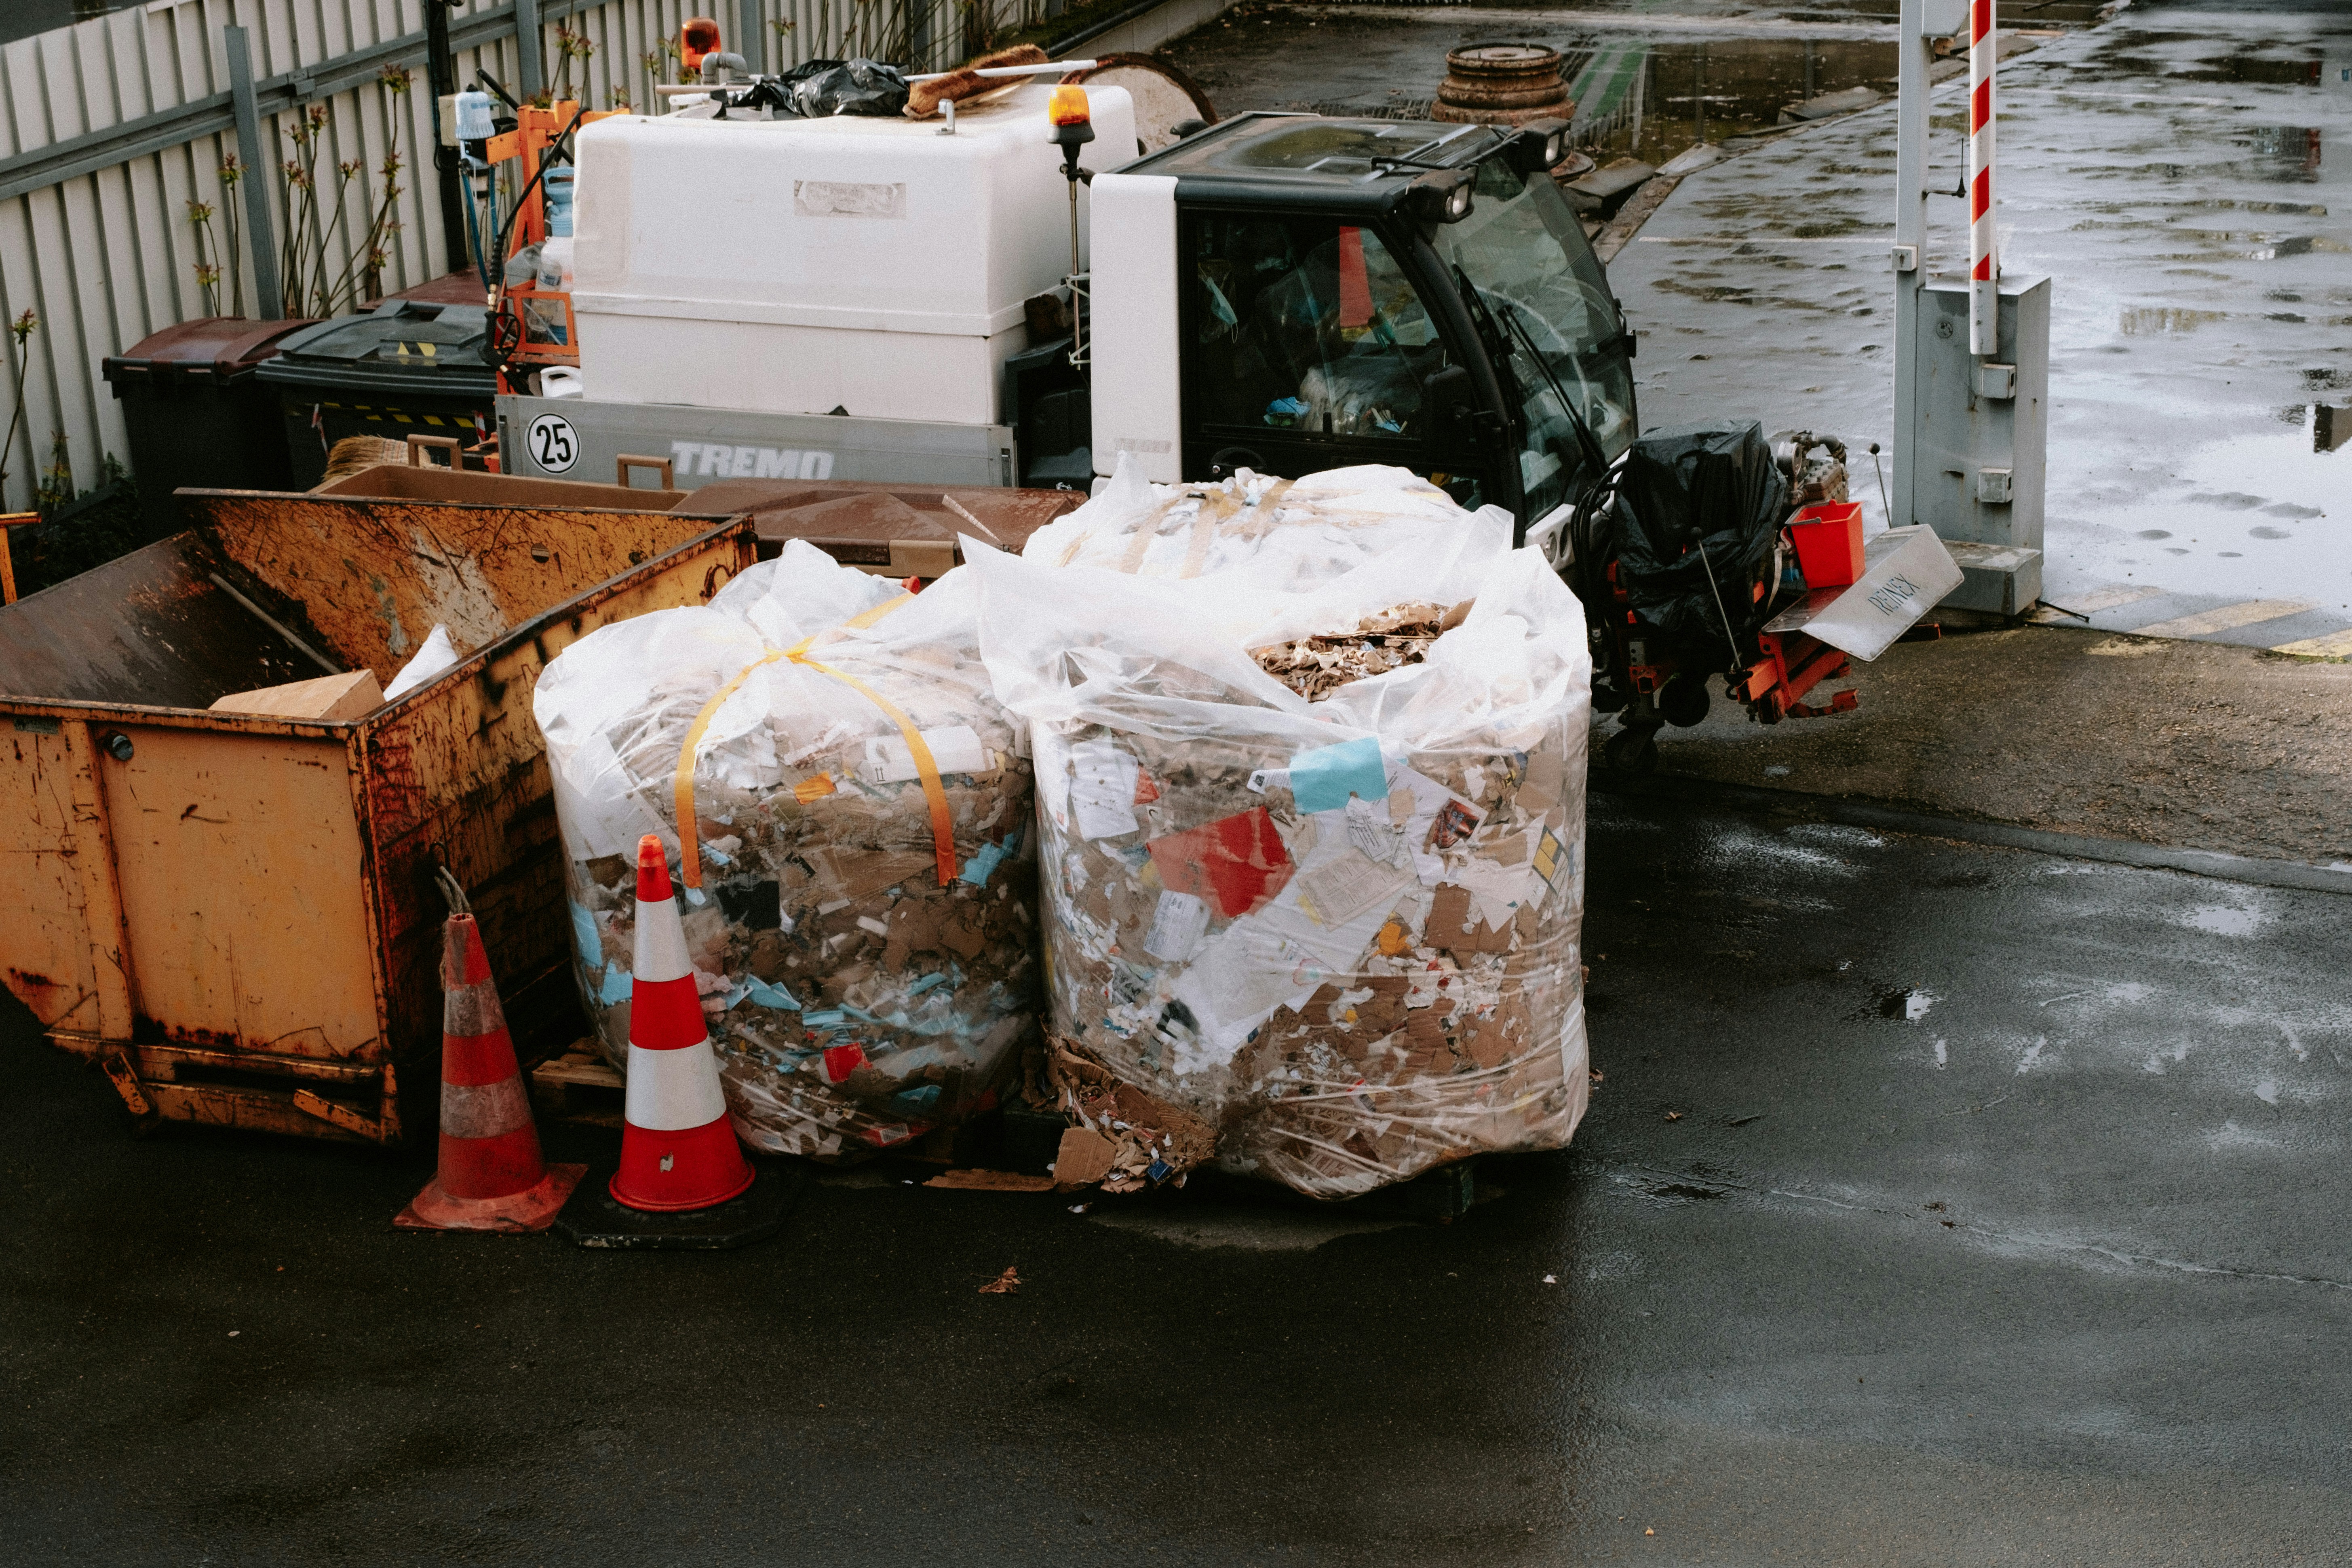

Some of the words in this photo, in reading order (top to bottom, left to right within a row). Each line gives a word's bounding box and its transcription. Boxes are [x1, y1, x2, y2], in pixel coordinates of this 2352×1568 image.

[536, 423, 571, 464] 25
[670, 441, 835, 480] TREMO
[1868, 573, 1920, 616] REINEX
